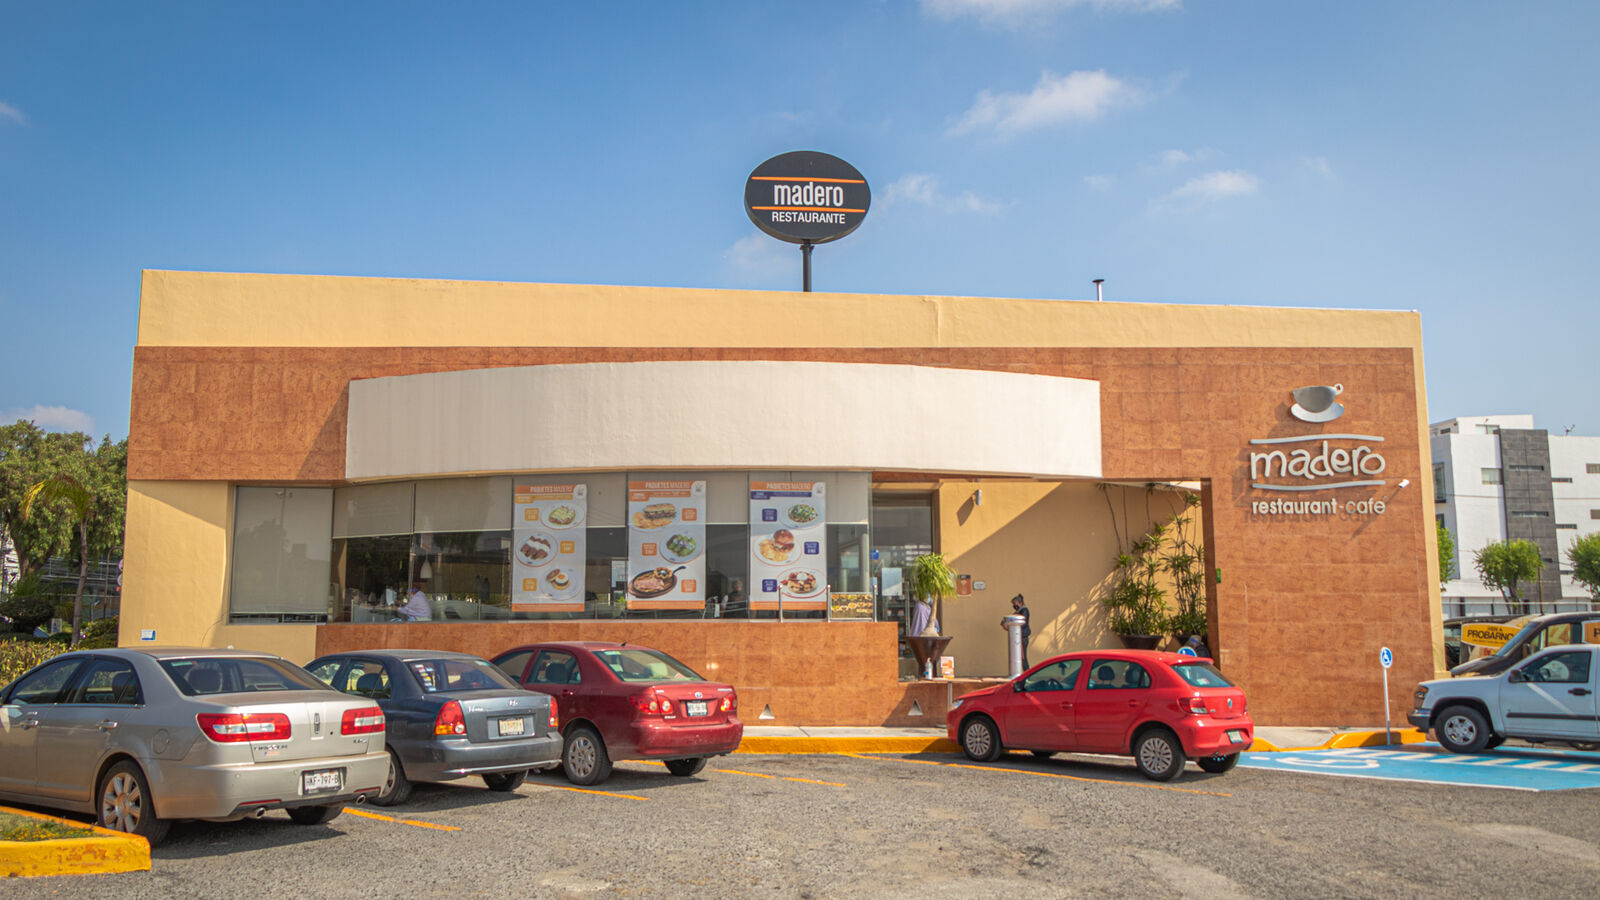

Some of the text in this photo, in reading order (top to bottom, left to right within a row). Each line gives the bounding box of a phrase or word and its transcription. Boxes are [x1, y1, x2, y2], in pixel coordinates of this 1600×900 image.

[773, 181, 844, 207] madero
[771, 211, 846, 224] RESTAURANTE
[1250, 440, 1386, 480] madero
